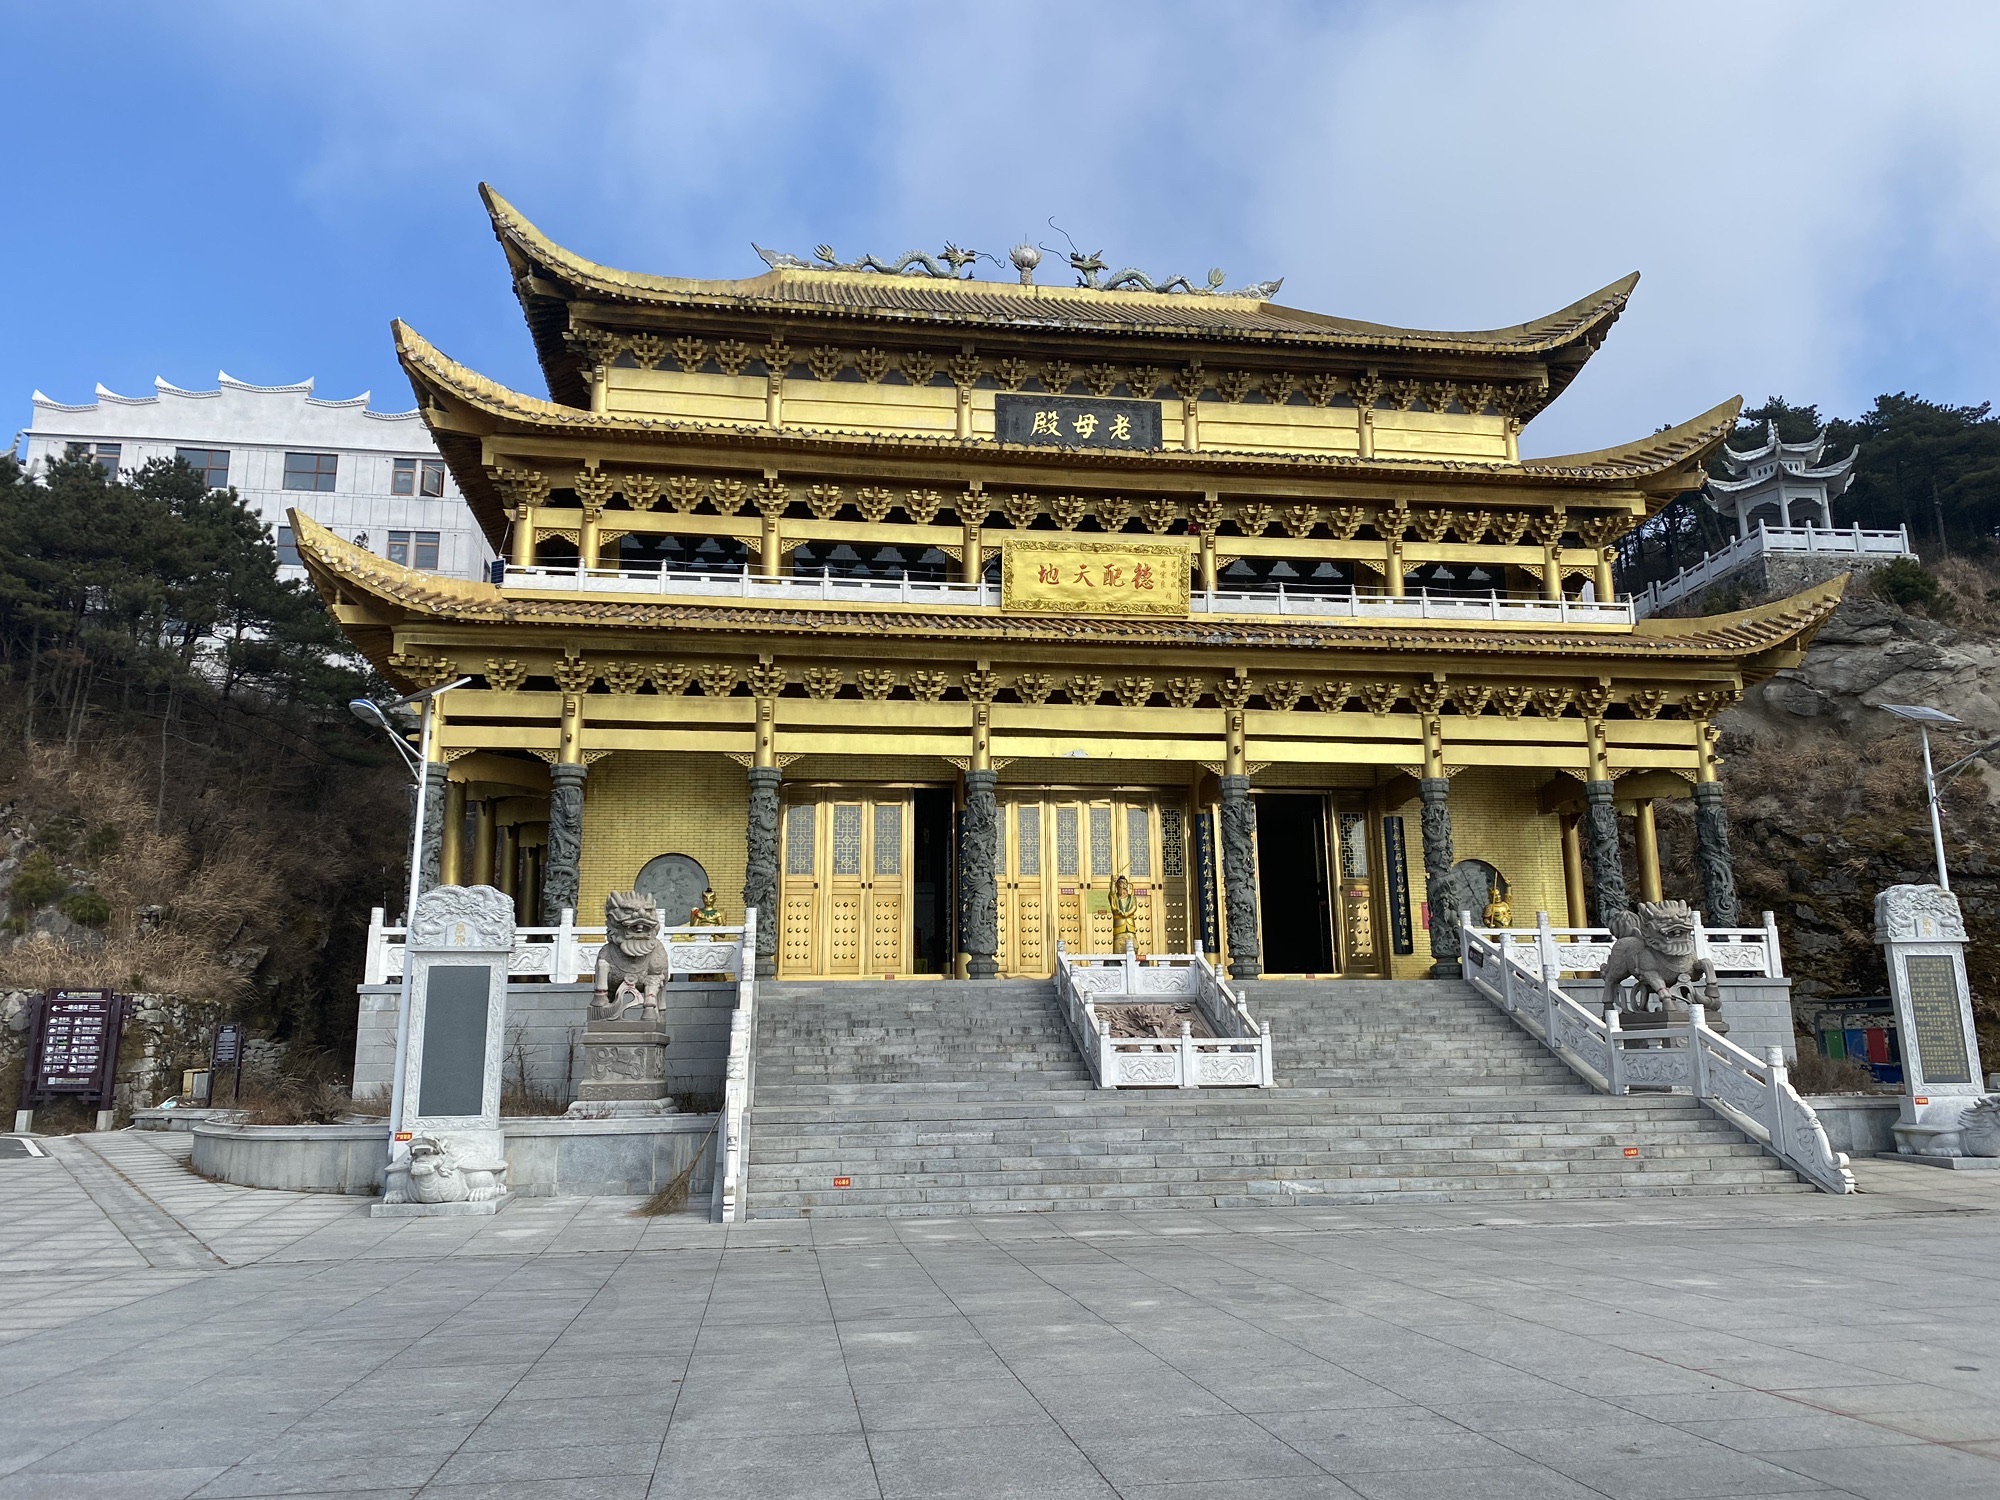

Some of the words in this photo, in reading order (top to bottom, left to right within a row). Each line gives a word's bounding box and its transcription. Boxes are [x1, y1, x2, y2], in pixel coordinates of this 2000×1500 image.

[1030, 410, 1132, 441] 老母殿
[1037, 563, 1155, 590] 德配天地
